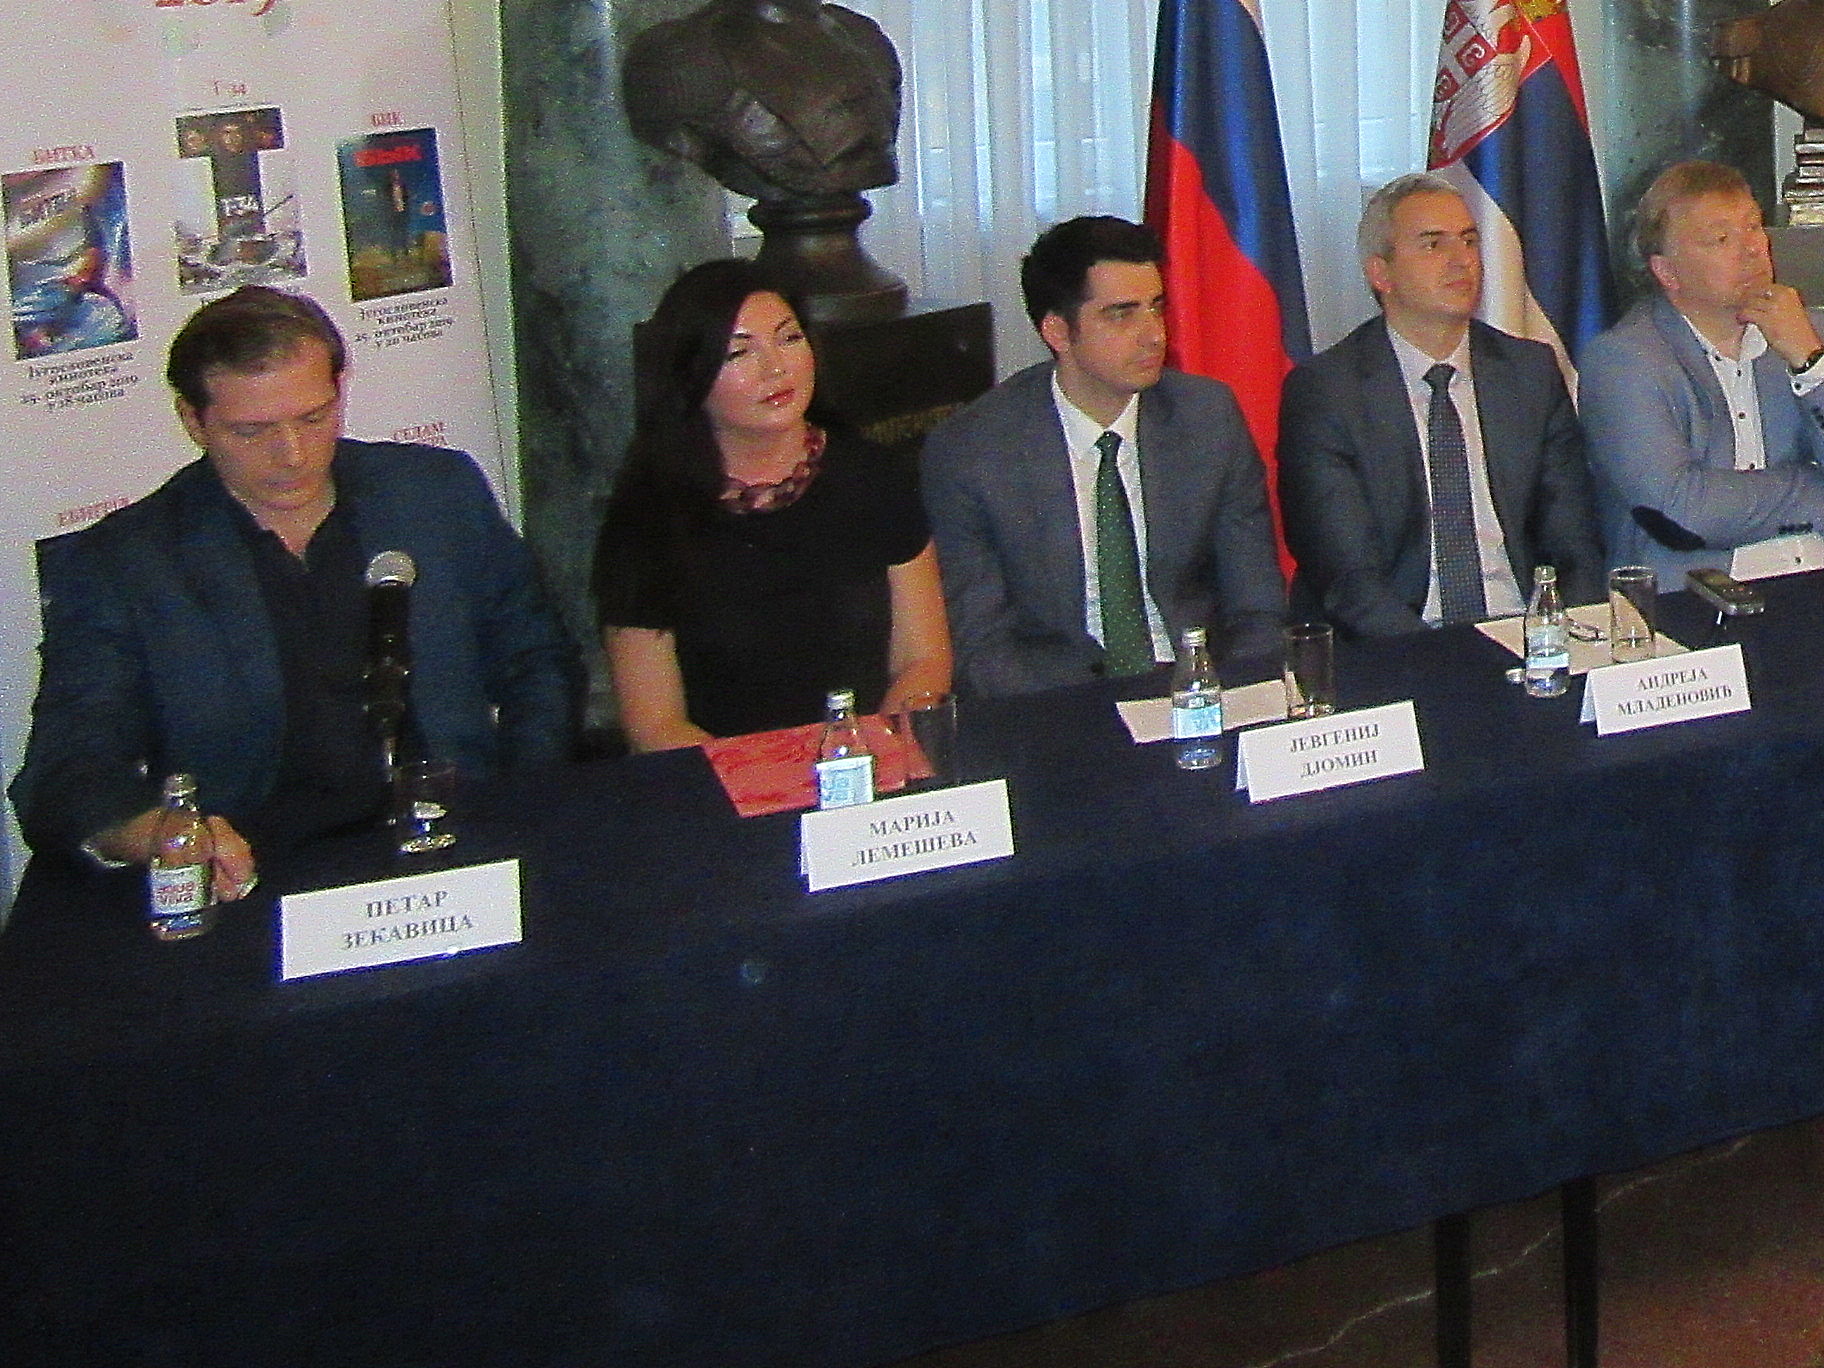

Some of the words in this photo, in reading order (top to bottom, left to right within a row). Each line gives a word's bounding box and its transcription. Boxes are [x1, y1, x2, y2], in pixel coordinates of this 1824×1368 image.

[1636, 667, 1708, 692] АНДРЕЈА
[1617, 684, 1733, 716] МЛАДЕНОВИЋ
[1290, 723, 1379, 753] ЈЕВГЕНИЈ
[1300, 749, 1378, 779] ДЈОМИН
[868, 809, 955, 837] МАРИЈА
[851, 830, 978, 868] ЛЕМЕШЕВА
[365, 890, 449, 918] ПЕТАР
[341, 913, 473, 950] ЗЕКАВИЦА
